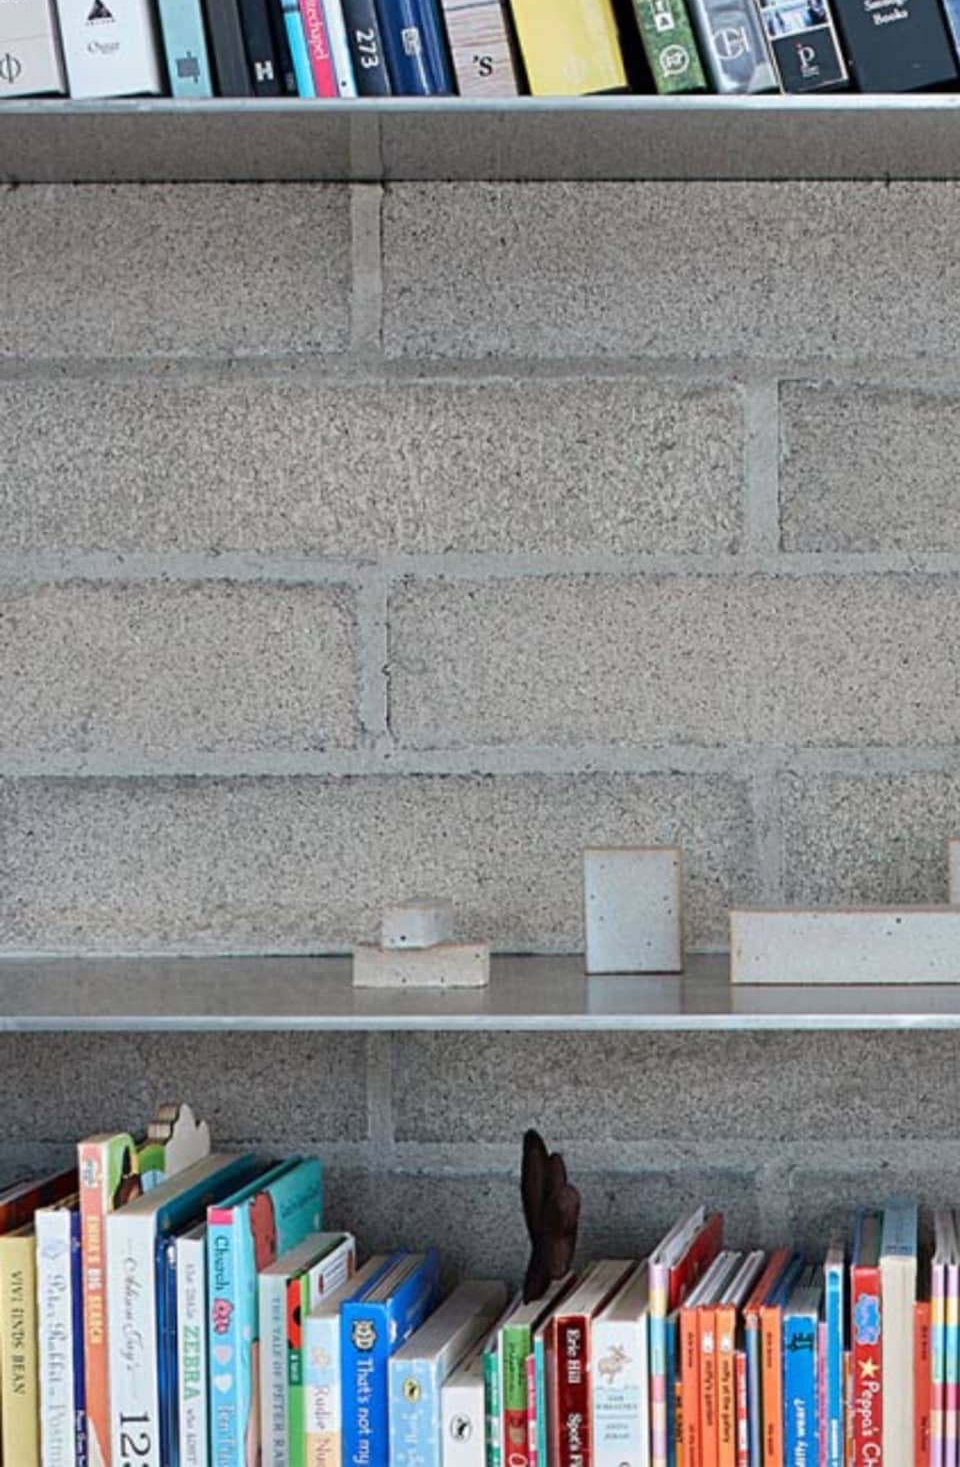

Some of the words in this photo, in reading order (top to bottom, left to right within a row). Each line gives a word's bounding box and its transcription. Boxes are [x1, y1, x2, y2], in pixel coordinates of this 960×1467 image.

[872, 8, 909, 26] Books
[352, 25, 380, 70] 273
[214, 1235, 229, 1291] Church
[11, 1270, 25, 1302] VIVI
[183, 1325, 201, 1401] ZEBRA
[566, 1329, 581, 1358] Eric
[12, 1354, 26, 1395] BEAN
[357, 1357, 375, 1404] That's
[567, 1359, 582, 1384] Hill
[272, 1383, 285, 1434] PETER
[314, 1384, 332, 1431] Rudie
[357, 1406, 373, 1435] not
[856, 1381, 880, 1436] Peppa's
[353, 1440, 370, 1464] my
[566, 1412, 583, 1451] Spot's
